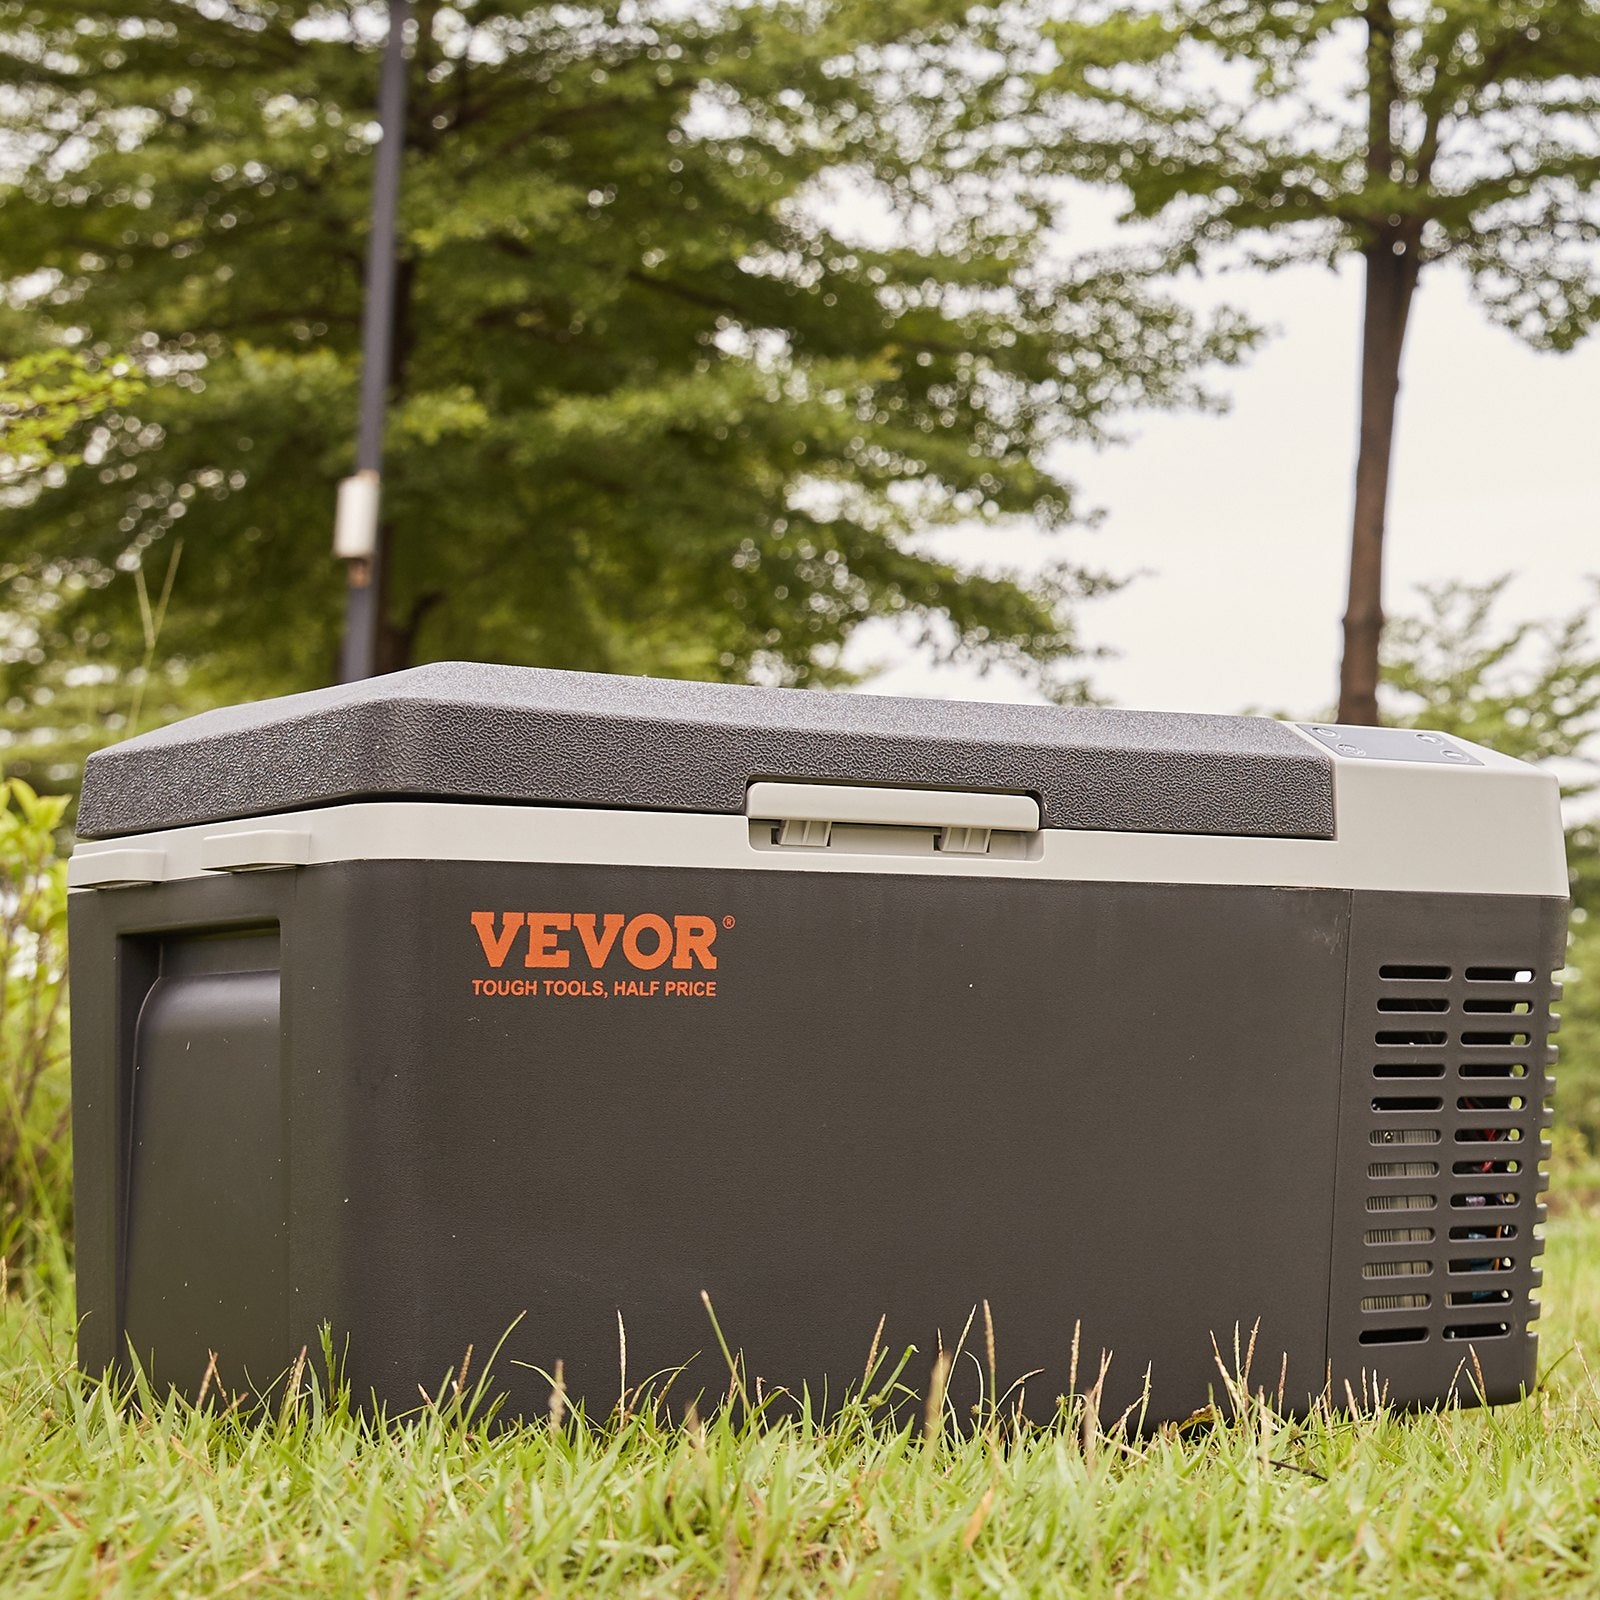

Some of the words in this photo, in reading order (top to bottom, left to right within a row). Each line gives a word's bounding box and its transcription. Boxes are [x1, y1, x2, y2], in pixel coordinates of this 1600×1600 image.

[471, 979, 538, 997] TOUGH
[542, 980, 609, 998] TOOLS,
[613, 981, 660, 997] HALF
[664, 981, 717, 997] PRICE
